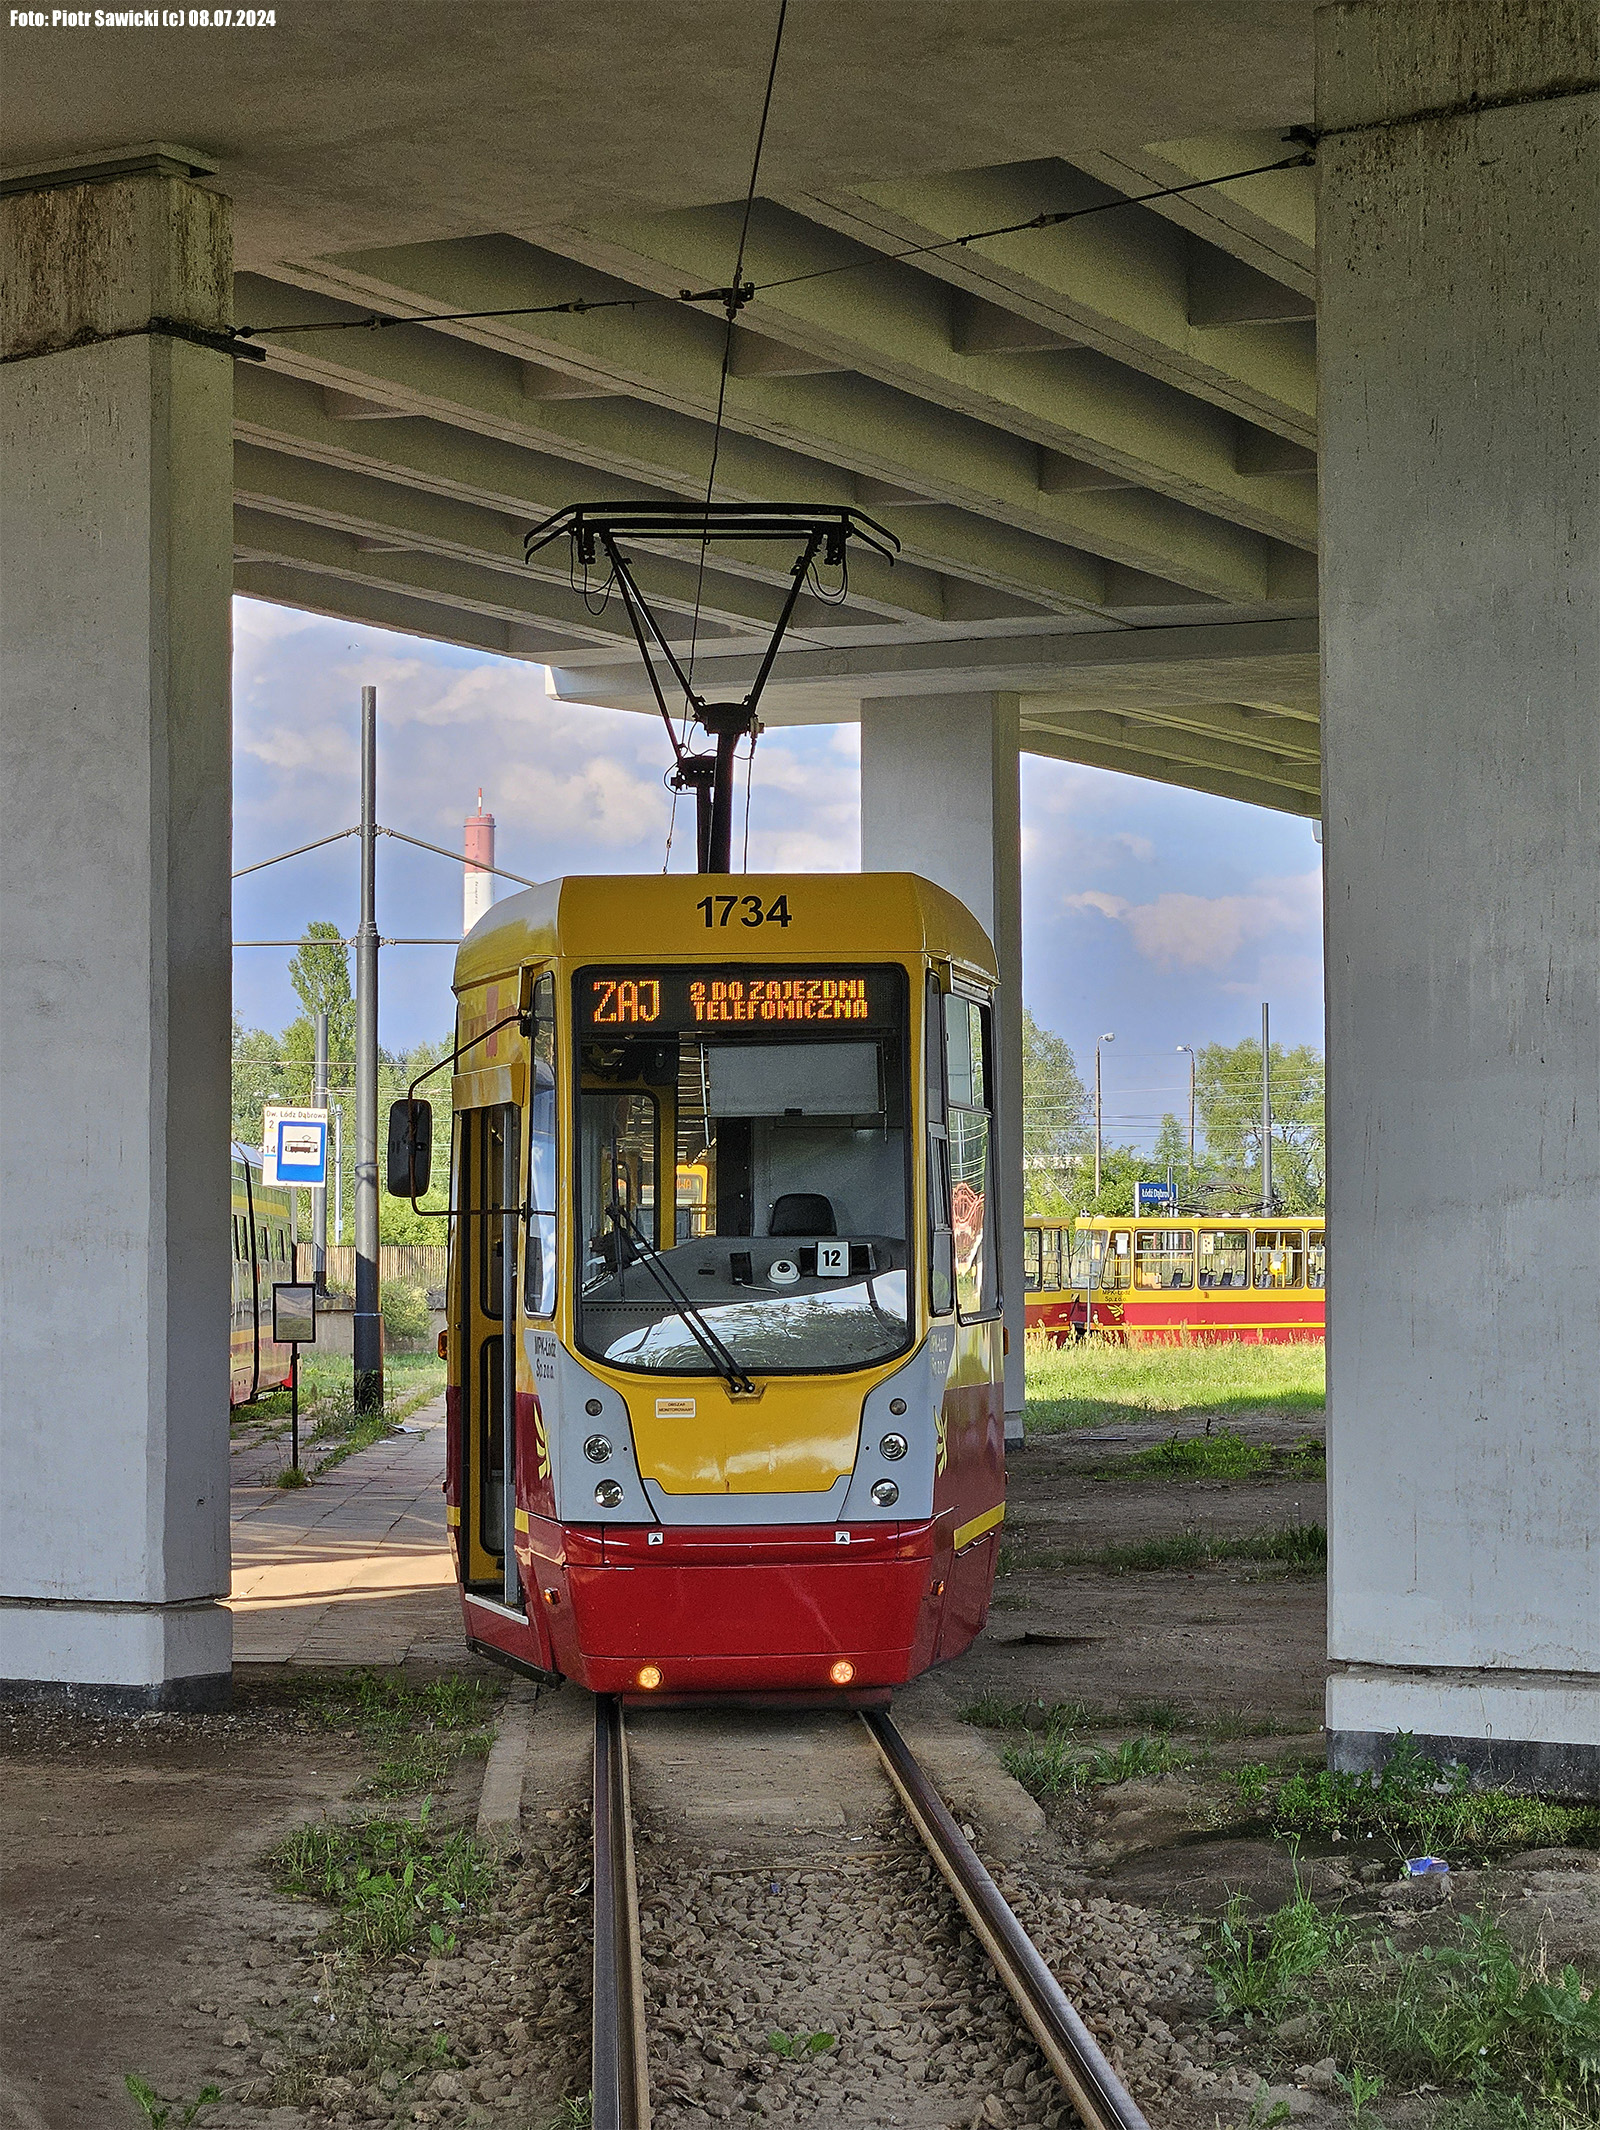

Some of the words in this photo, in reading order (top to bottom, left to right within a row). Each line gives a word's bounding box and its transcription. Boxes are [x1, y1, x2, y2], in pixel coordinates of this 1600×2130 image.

[696, 895, 793, 929] 1734
[690, 981, 706, 1001] 2
[711, 981, 743, 1001] DO
[749, 980, 865, 1000] ZAJEZDNI
[593, 980, 660, 1022] ZAJ
[693, 1000, 868, 1020] TELEFONICZNA
[269, 1119, 275, 1129] 2
[266, 1145, 276, 1154] 14
[822, 1249, 842, 1267] 12
